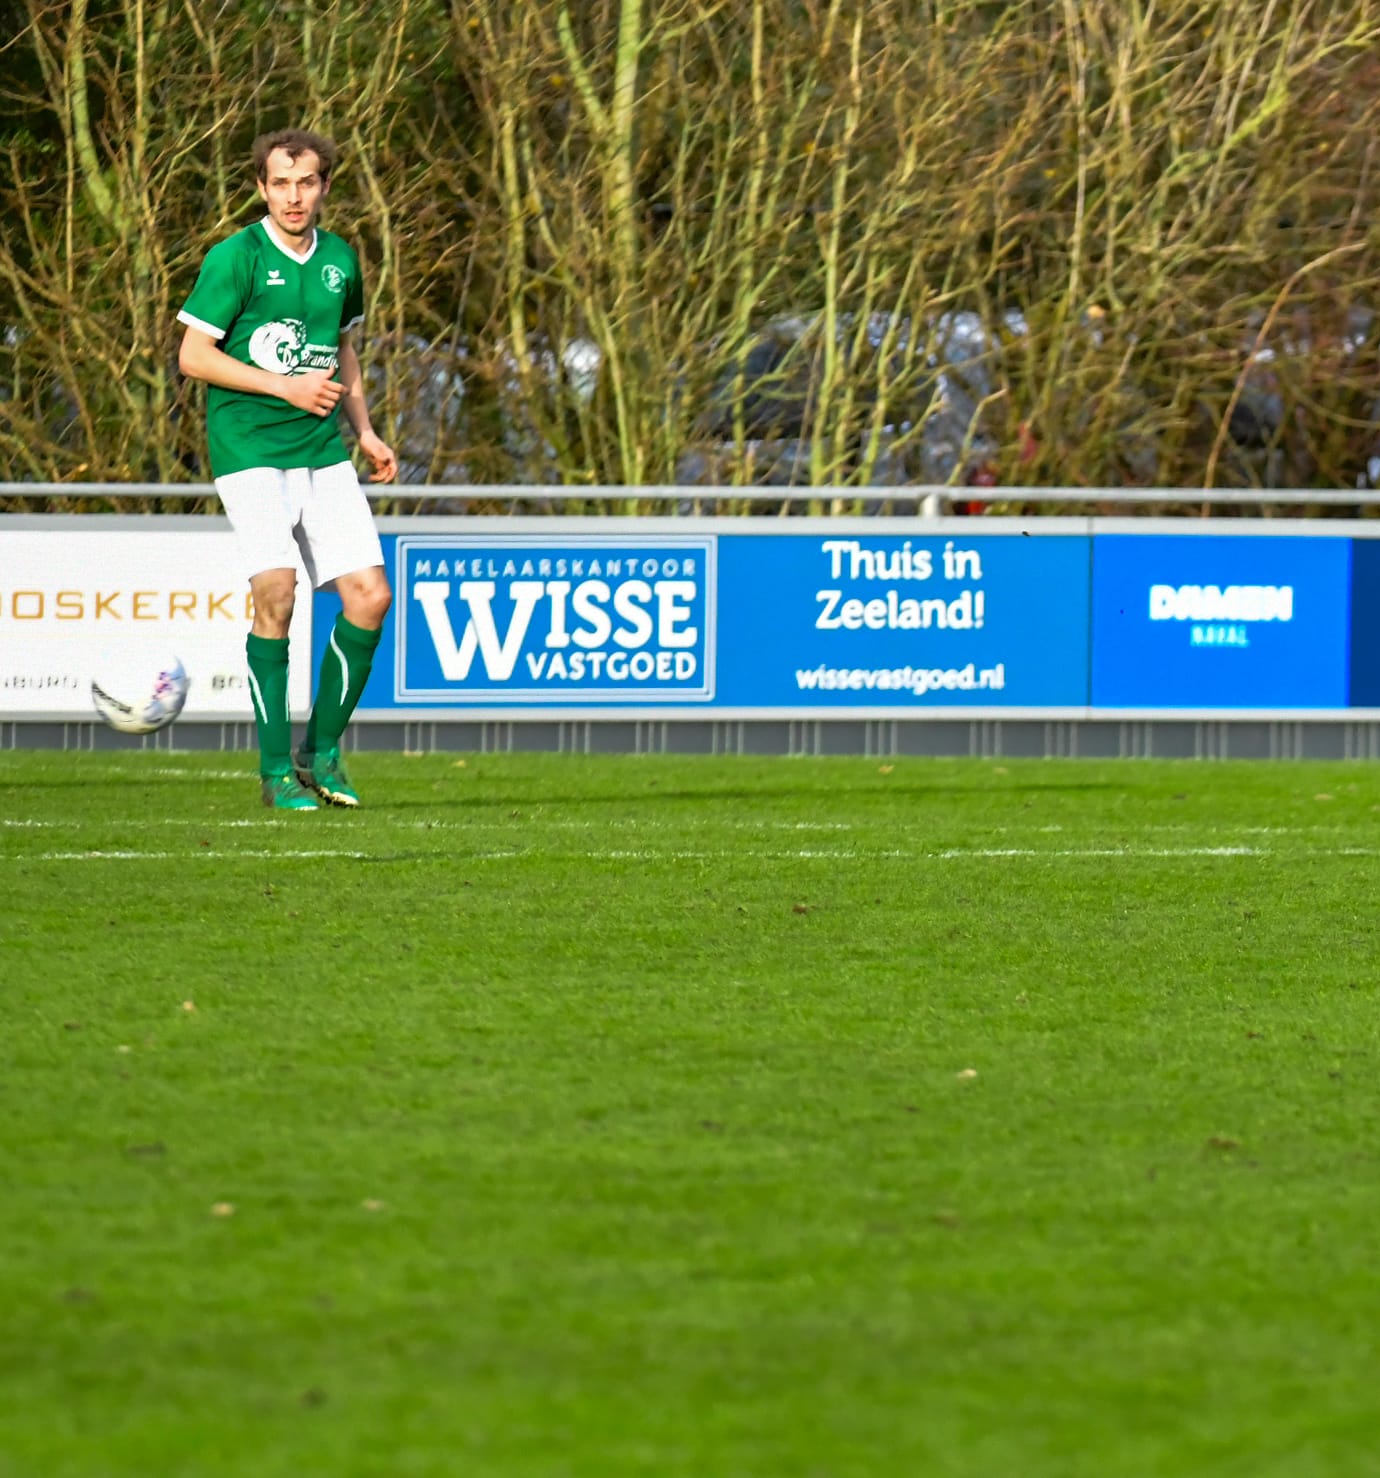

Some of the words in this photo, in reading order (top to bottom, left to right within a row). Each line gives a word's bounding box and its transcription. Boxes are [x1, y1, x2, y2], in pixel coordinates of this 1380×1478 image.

[414, 558, 696, 577] MAKELAARSKANTOOR
[821, 541, 933, 580] Thuis
[942, 541, 983, 580] in
[0, 591, 255, 620] OSKERK
[815, 590, 985, 630] Zeeland!
[1150, 585, 1293, 621] DAMEN
[413, 580, 698, 681] WISSE
[526, 652, 697, 680] VASTGOED
[795, 664, 1005, 696] wissevastgoed.nl
